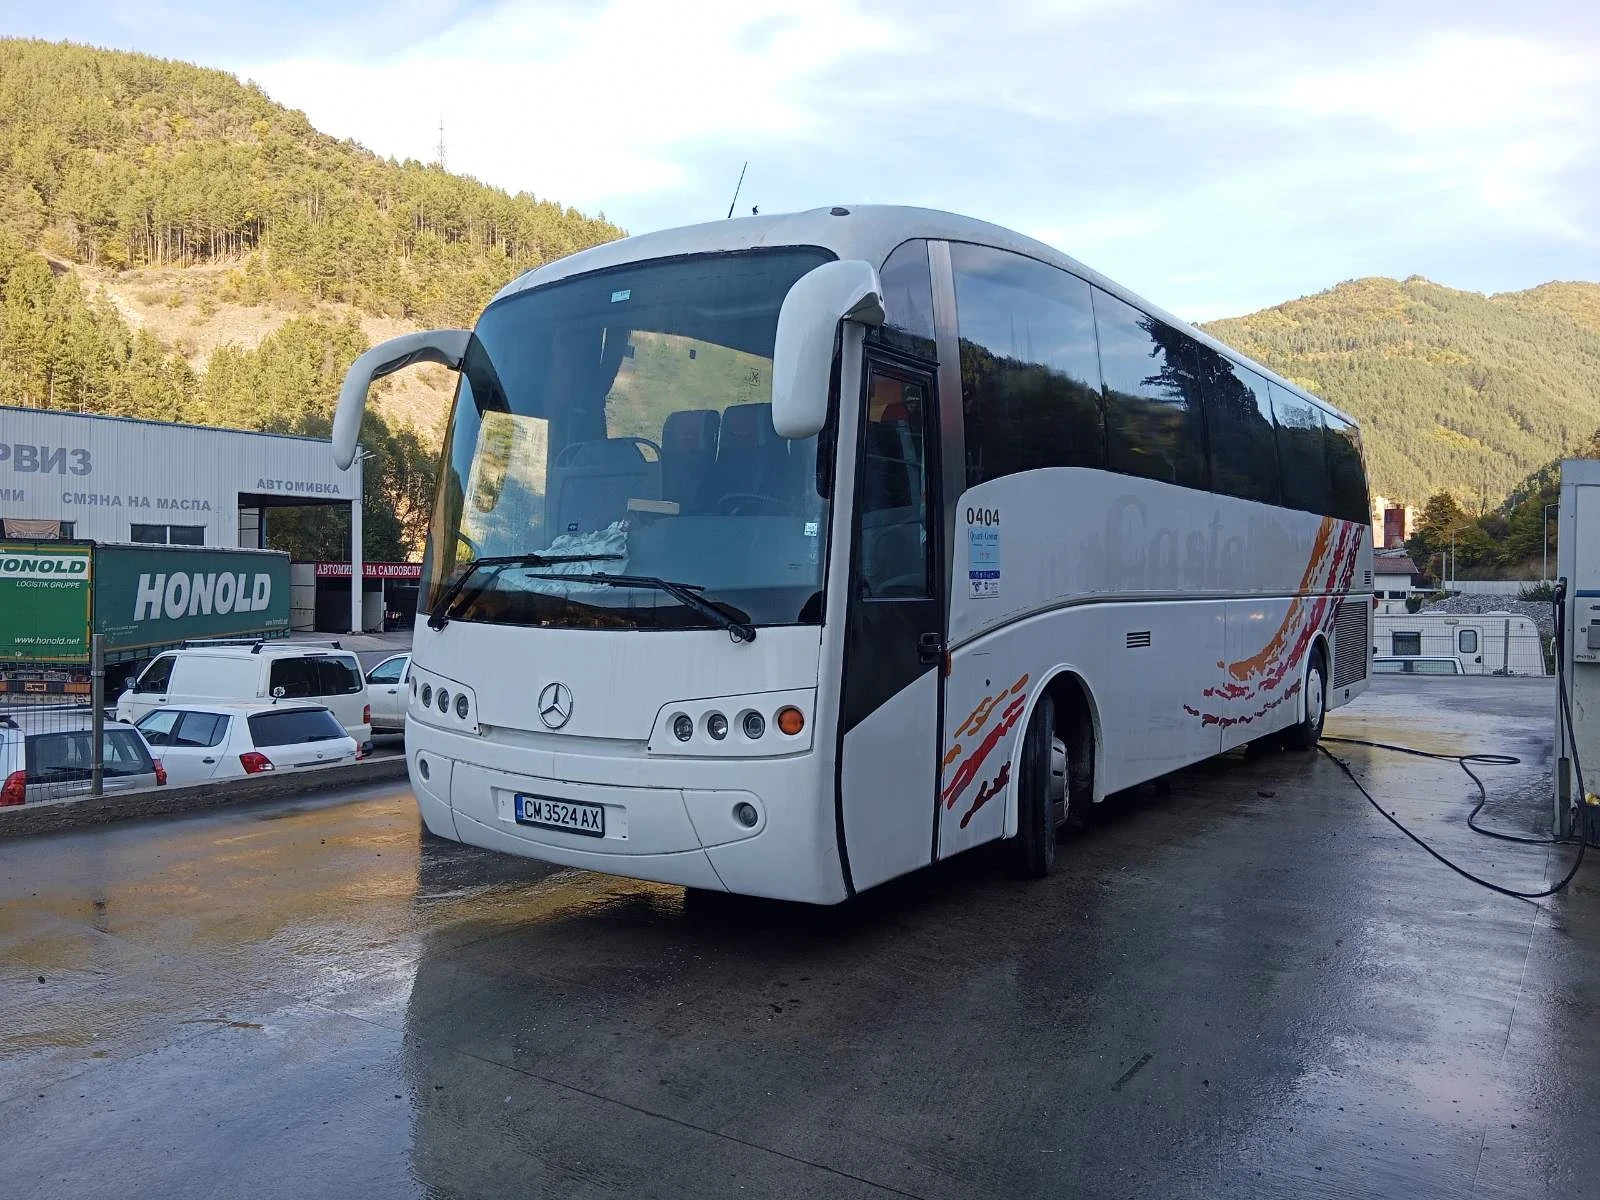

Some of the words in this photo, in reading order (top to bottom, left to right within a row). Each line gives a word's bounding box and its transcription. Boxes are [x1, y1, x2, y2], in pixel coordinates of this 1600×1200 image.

[257, 478, 340, 494] АВТОМИВКА
[62, 492, 122, 507] СМЯНА
[128, 495, 150, 508] НА
[156, 498, 211, 511] МАСЛА
[967, 507, 1000, 526] 0404
[0, 559, 87, 574] ONOLD
[366, 565, 377, 575] НА
[16, 580, 49, 588] LOGISTIK
[50, 581, 81, 589] GRUPPE
[133, 571, 272, 621] HONOLD
[15, 636, 80, 645] www.honold.net
